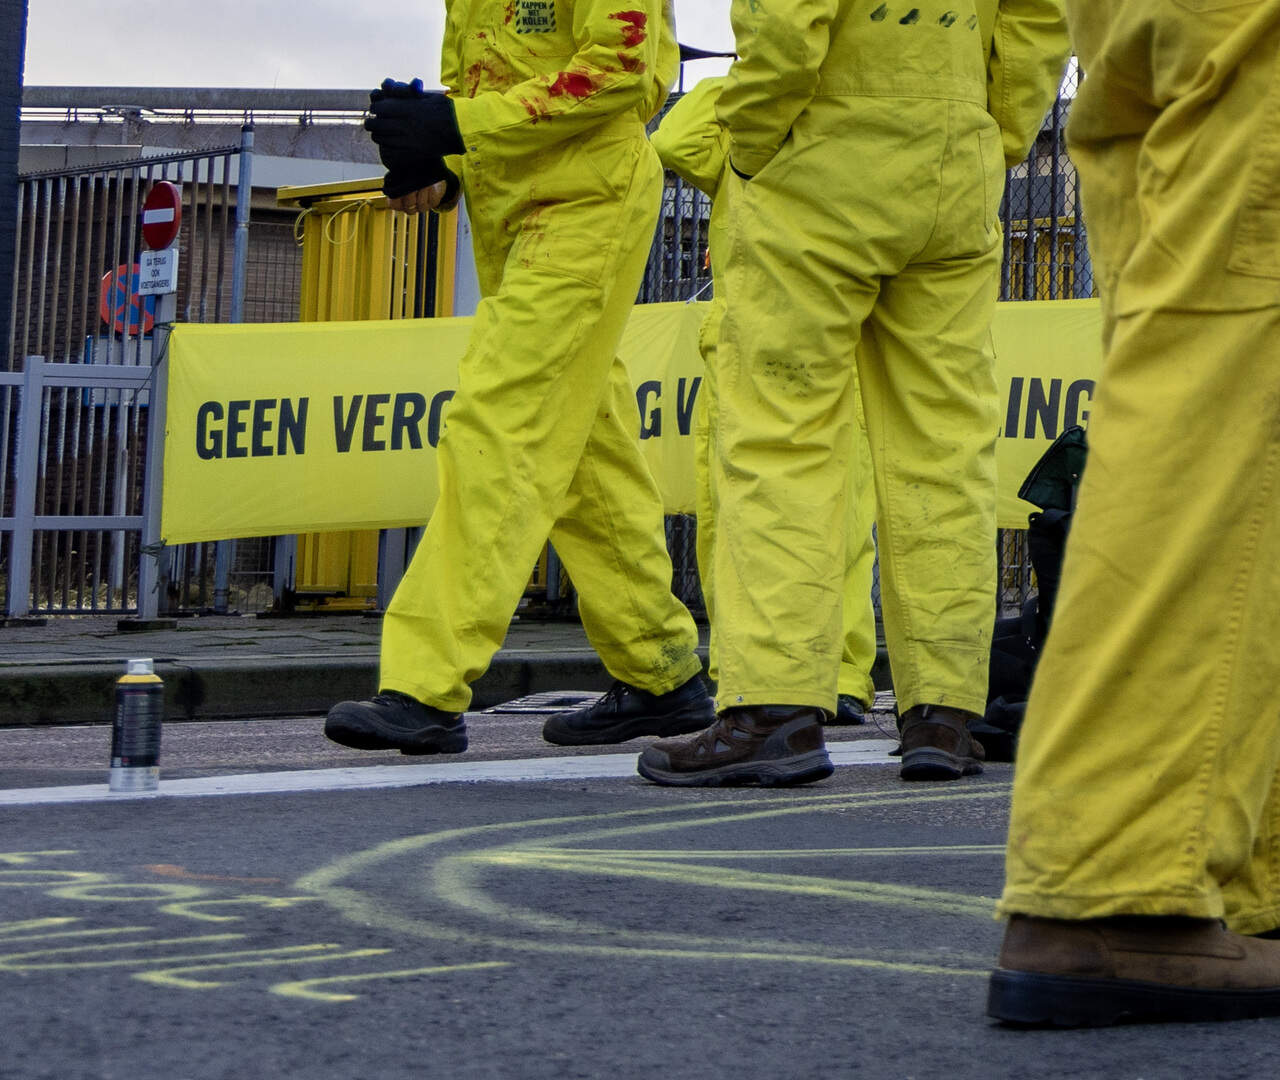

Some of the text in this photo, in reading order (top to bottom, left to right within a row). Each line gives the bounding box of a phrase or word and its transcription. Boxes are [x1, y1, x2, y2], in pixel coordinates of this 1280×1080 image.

[521, 1, 547, 10] KAPPEN
[522, 17, 548, 26] KOLEN
[196, 396, 309, 460] GEEN
